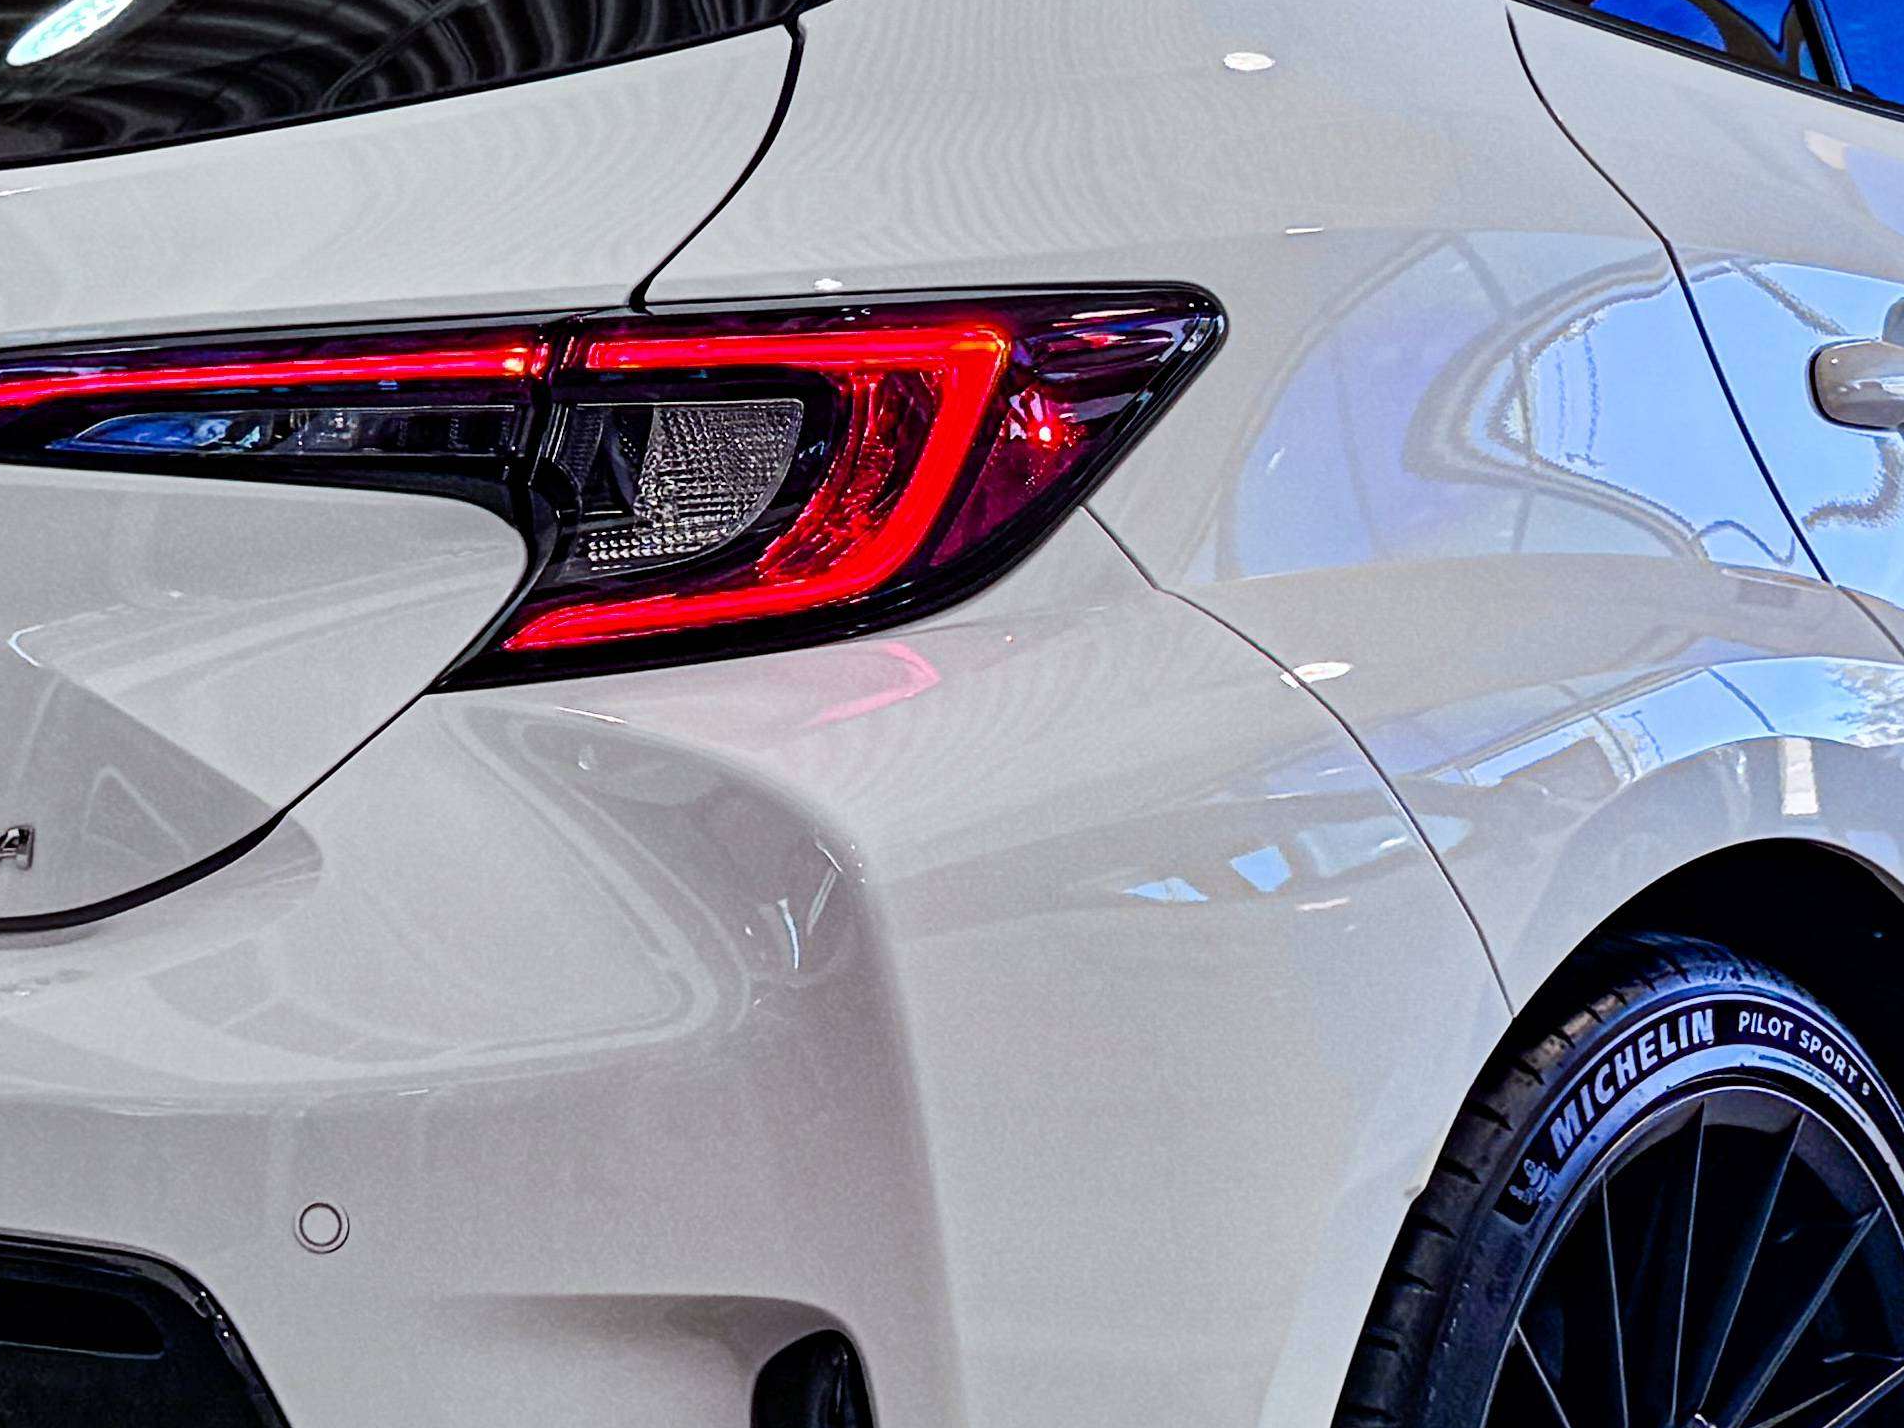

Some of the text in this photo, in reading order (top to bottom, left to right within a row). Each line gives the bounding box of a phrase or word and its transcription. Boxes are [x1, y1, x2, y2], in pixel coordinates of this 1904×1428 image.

[1550, 1008, 1859, 1159] MICHELIN PILOT SPORT
